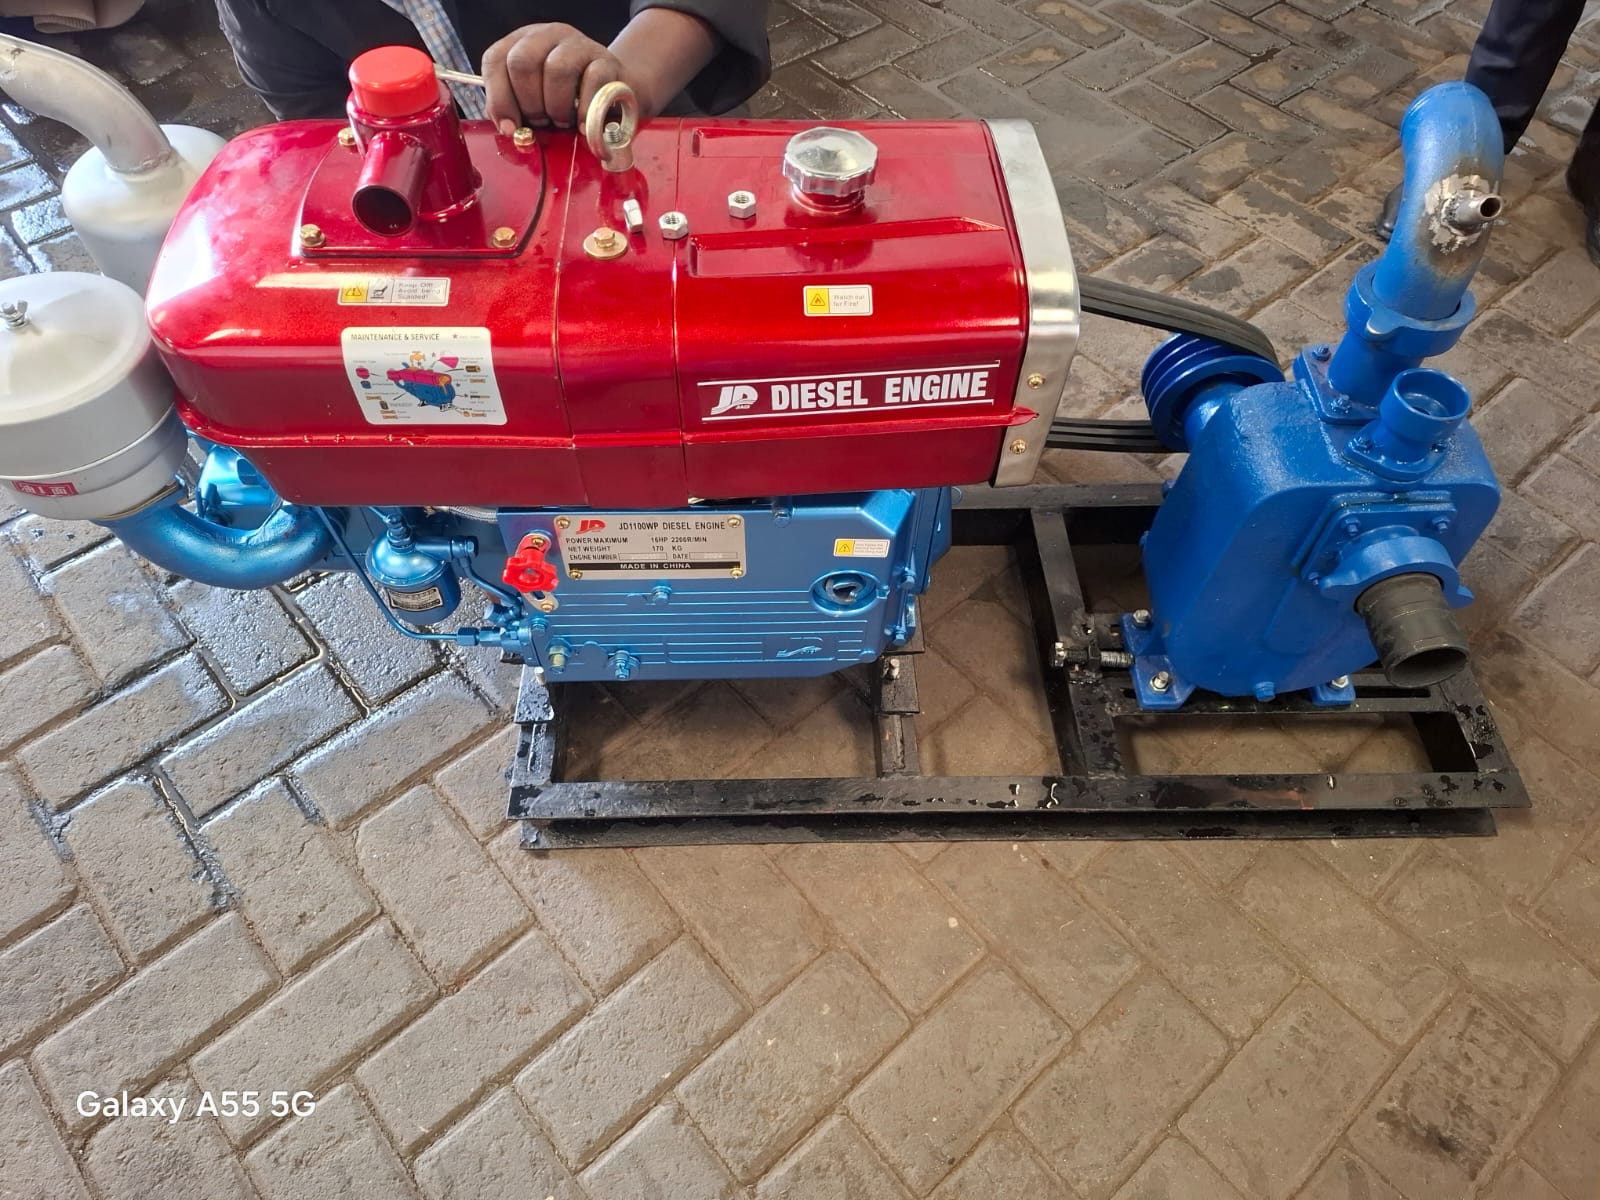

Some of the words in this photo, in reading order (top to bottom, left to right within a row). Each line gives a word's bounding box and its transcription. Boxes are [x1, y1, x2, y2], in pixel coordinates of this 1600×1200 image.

[350, 333, 403, 341] MAINTENANCE
[404, 333, 409, 341] &
[410, 333, 440, 341] SERVICE
[771, 380, 868, 411] DIESEL
[885, 371, 989, 404] ENGINE
[618, 522, 659, 531] JD1100WP
[662, 521, 692, 530] DIESEL
[695, 521, 726, 530] ENGINE
[569, 553, 592, 561] ENGINE
[592, 553, 618, 561] NUMBER
